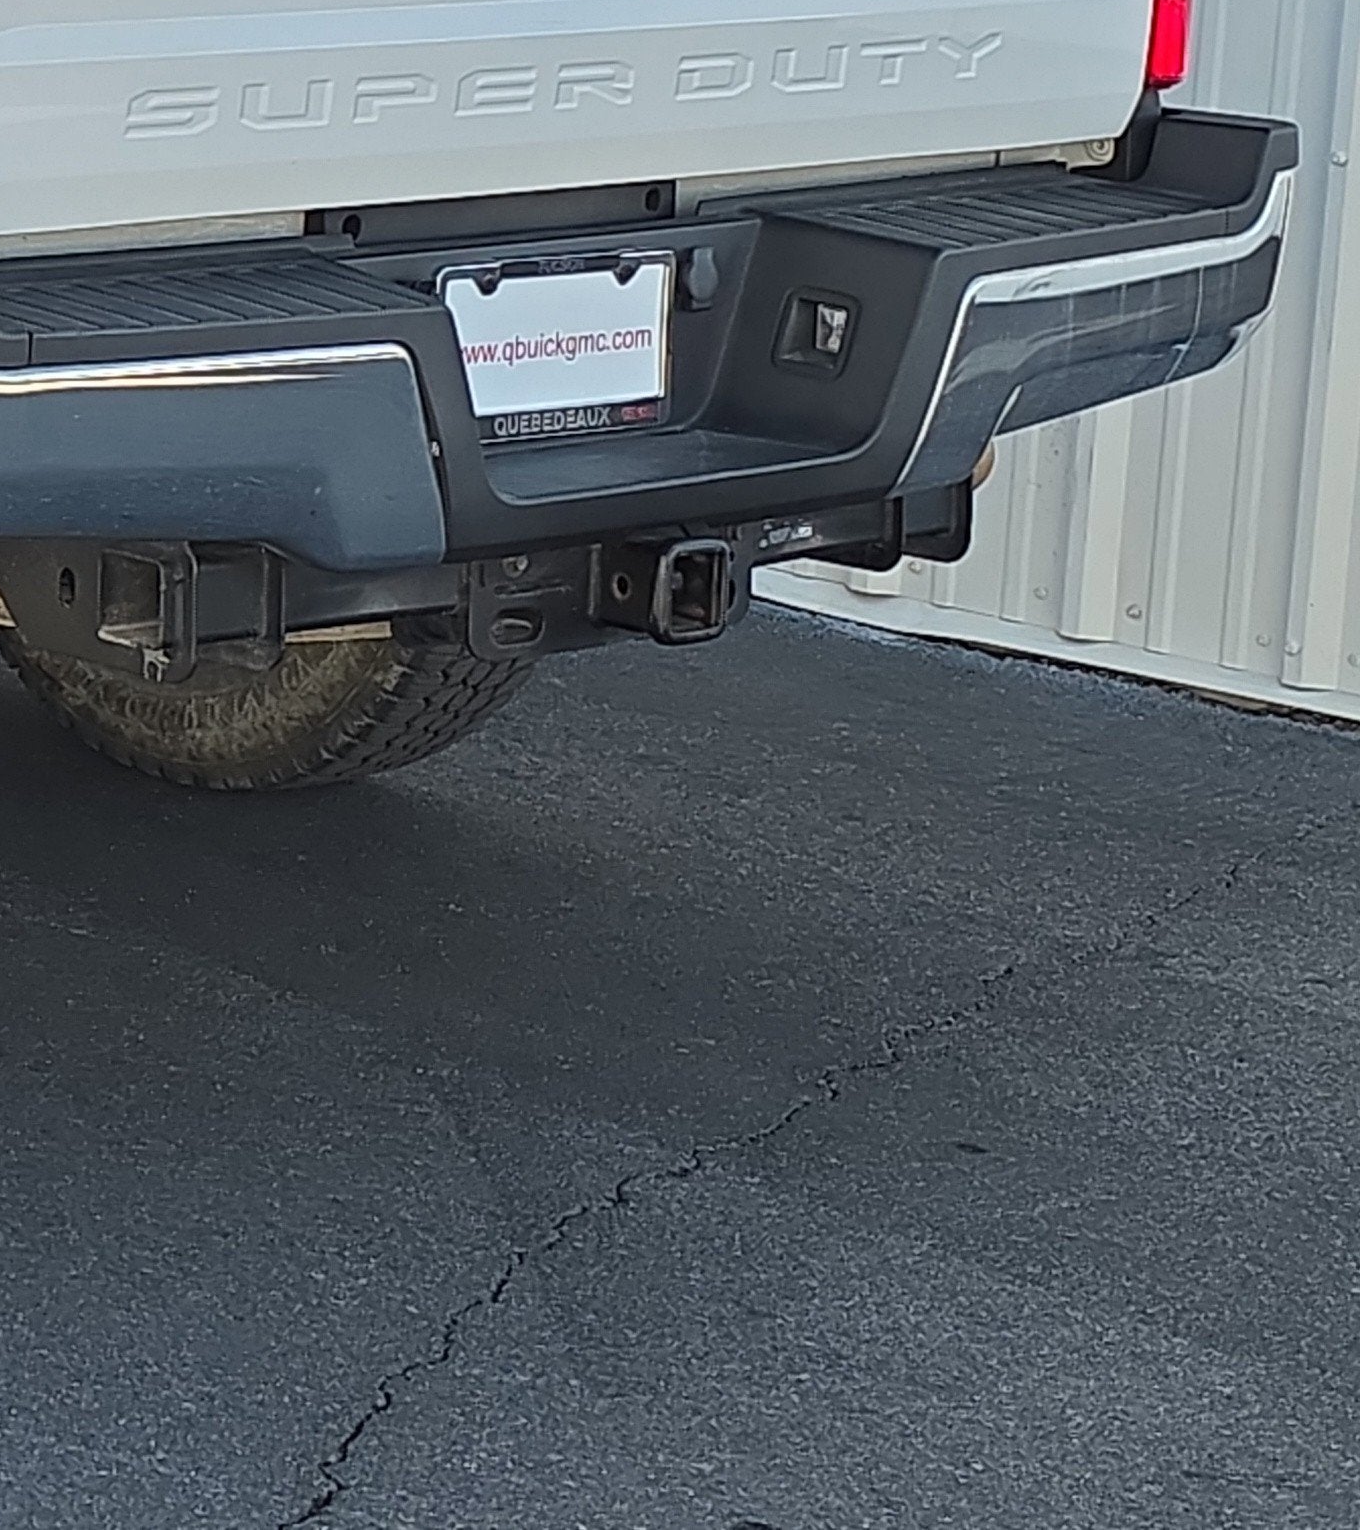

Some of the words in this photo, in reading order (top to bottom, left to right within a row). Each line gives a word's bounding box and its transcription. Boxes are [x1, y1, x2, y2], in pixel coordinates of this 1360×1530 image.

[122, 57, 636, 139] SUPER
[673, 30, 1005, 102] DUTY
[461, 327, 652, 366] ww.qbuickgmc.com
[492, 406, 612, 437] QUEBEDEAUX
